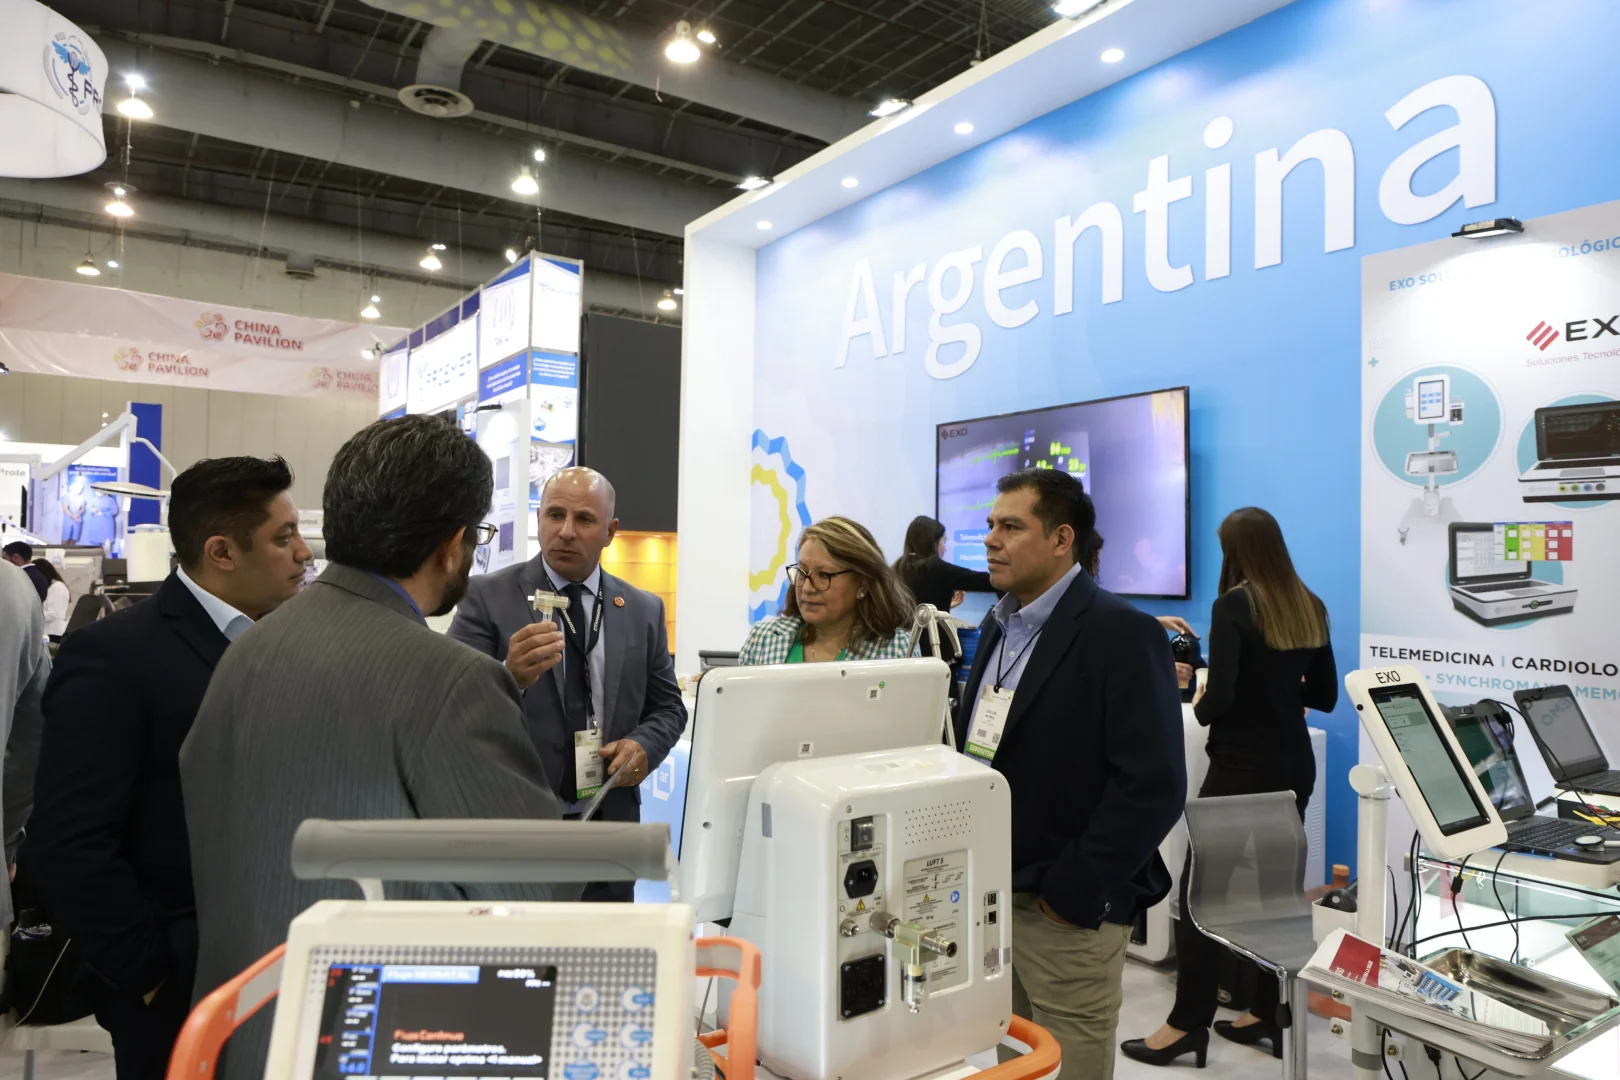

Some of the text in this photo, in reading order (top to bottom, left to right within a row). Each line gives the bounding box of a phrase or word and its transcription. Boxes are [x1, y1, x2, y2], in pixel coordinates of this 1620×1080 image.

[834, 74, 1497, 380] Argentina
[1389, 277, 1415, 291] EXO
[234, 320, 280, 335] CHINA
[234, 332, 303, 351] PAVILION
[147, 352, 190, 364] CHINA
[1526, 354, 1579, 367] Soluciones
[147, 363, 209, 377] PAVILION
[336, 371, 372, 383] CHINA
[950, 428, 968, 438] EXO
[1370, 646, 1618, 677] TELEMEDICINA CARDIOLO
[1375, 670, 1401, 684] EXO
[1575, 686, 1620, 701] MEM
[969, 744, 995, 758] EXPOSITOR
[926, 858, 940, 867] LUFT
